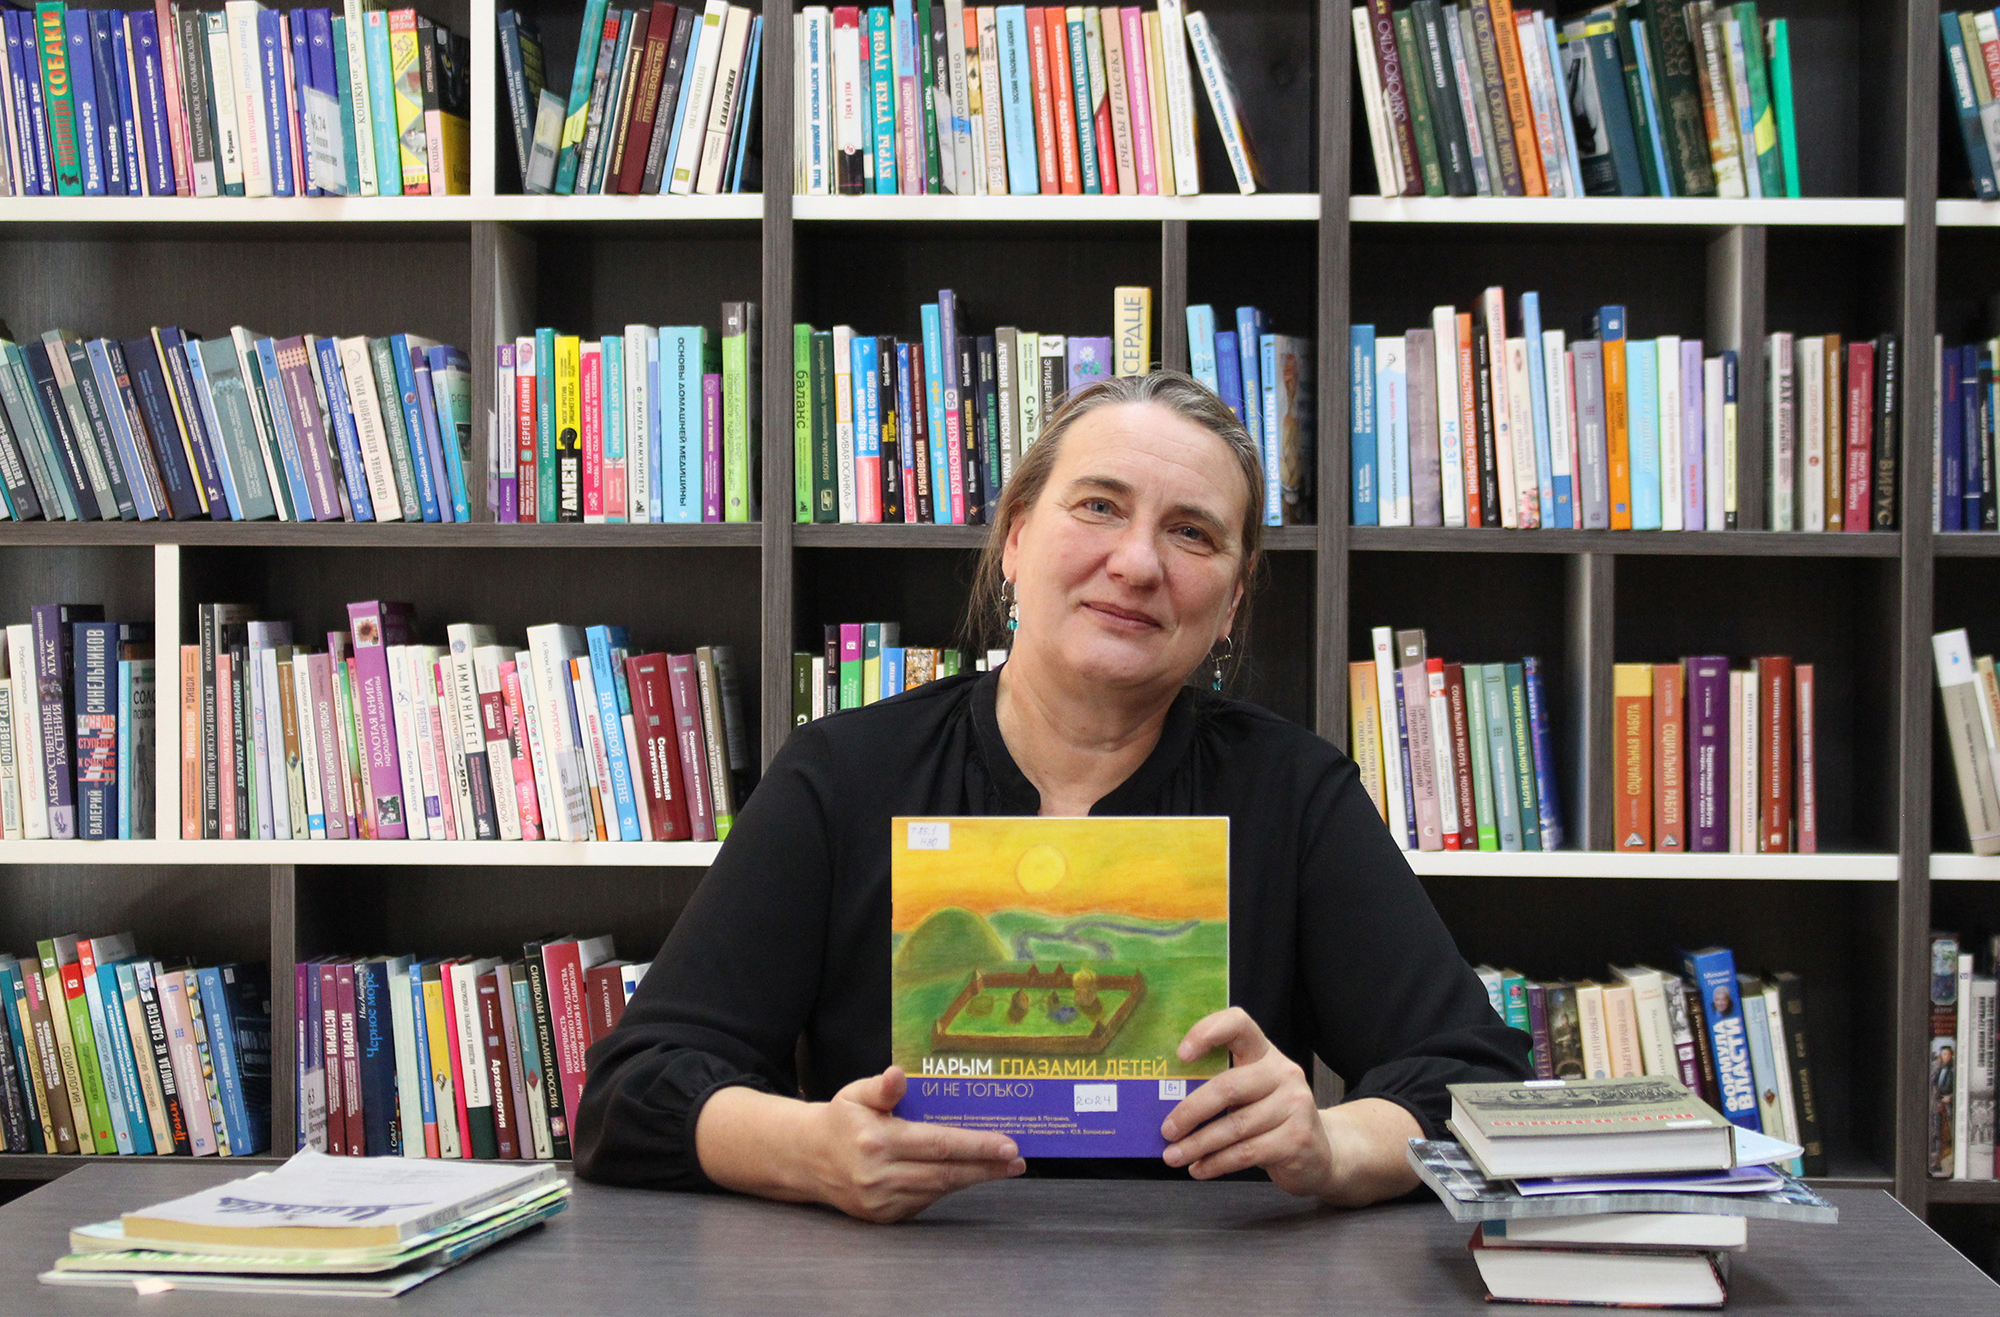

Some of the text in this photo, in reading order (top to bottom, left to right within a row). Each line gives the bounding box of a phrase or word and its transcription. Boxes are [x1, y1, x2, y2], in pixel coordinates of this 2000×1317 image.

[42, 11, 67, 96] СОБАКИ
[241, 52, 251, 89] собака
[267, 50, 275, 76] собак
[642, 42, 665, 123] ПТИЦЕВОДСТВО
[1378, 20, 1406, 121] ЗВЕРОВОДСТВО
[31, 83, 41, 103] дог
[185, 21, 205, 157] ПРАКТИЧЕСКОЕ СОБАКОВОДСТВО
[247, 95, 257, 144] ВОСПИТАНИЕ
[354, 82, 366, 124] КОШКИ
[688, 66, 706, 129] ПТИЦЕВОДСТВО
[873, 30, 891, 179] КУРЫ УТКИ ГУСИ
[953, 54, 965, 144] ПЧЕЛОВОДСТВО
[1071, 25, 1094, 186] НАСТОЛЬНАЯ КНИГА ПЧЕЛОВОДА
[1111, 48, 1129, 169] ПЧЕЛЫ И ПАСЕКА
[83, 101, 98, 189] Эрдельтерьер
[108, 125, 120, 182] Ротвейлер
[125, 120, 137, 190] Бассет хаунд
[579, 127, 597, 188] ДОМАШНЯЯ ПТИЦА
[1059, 100, 1073, 183] ПЧЕЛОВОДСТВО
[1122, 296, 1142, 374] СЕРДЦЕ
[354, 375, 366, 395] ВРАЧА
[522, 378, 531, 445] СЕРГЕЙ АГАПКИН
[610, 362, 620, 454] СПАСАЮТ ПЕРВЫМ?
[678, 383, 686, 443] ДОМАШНЕЙ
[796, 370, 808, 429] баланс
[867, 371, 876, 409] СОСУДОВ
[999, 343, 1010, 450] ЛЕЧЕБНАЯ ФИЗИЧЕСКАЯ
[1354, 345, 1362, 433] Здоровый человек
[1363, 356, 1371, 407] окружение
[83, 380, 121, 484] ОСНОВЫ ВЕТЕРИНАРИИ
[359, 400, 378, 453] ВЕТЕРИНАРНОГО
[386, 398, 407, 458] ВЕТЕРИНАРНОГО
[410, 409, 425, 455] Справочник
[857, 389, 866, 450] КОД ЗДОРОВЬЯ
[868, 418, 877, 450] СЕРДЦА
[1461, 348, 1477, 494] ГИМНАСТИКА ПРОТИВ СТАРЕНИЯ
[370, 457, 388, 500] СПРАВОЧНИК
[562, 457, 577, 510] АМЕН
[679, 446, 687, 506] МЕДИЦИНЫ
[916, 440, 927, 495] БУБНОВСКИЙ
[946, 417, 960, 495] БУБНОВСКИЙ
[1878, 460, 1894, 525] ВИРУС
[45, 640, 56, 675] АТЛАС
[87, 629, 104, 713] СИНЕЛЬНИКОВ
[53, 704, 66, 765] РАСТЕНИЯ
[185, 677, 195, 759] КОВИД ПОСТКОВИД
[232, 680, 245, 788] ИММУНИТЕТ АТАКУЕТ
[365, 678, 383, 767] ЗОЛОТАЯ КНИГА
[374, 676, 392, 766] народной медицины
[457, 664, 477, 746] ИММУНИТЕТ
[492, 695, 504, 736] ПОЛНЫЙ
[1451, 686, 1463, 737] СОЦИАЛЬНАЯ
[0, 721, 11, 761] ОЛИВЕР
[42, 705, 59, 805] ЛЕКАРСТВЕННЫЕ
[206, 686, 217, 810] ИСТОРИЯ РУССКОЙ МЕДИЦИНЫ
[319, 702, 331, 729] ОСНОВЫ
[327, 775, 339, 813] МЕДИЦИНЫ
[600, 692, 629, 804] НА ОДНОЙ ВОЛНЕ
[648, 739, 662, 799] статистика
[657, 737, 672, 800] Социальная
[1456, 738, 1466, 767] РАБОТА
[1512, 685, 1531, 808] ТЕОРИЯ СОЦИАЛЬНОЙ РАБОТЫ
[1627, 704, 1641, 795] СОЦИАЛЬНАЯ РАБОТА
[490, 744, 508, 823] СТРЕЛЬНИКОВОЙ
[688, 731, 704, 816] Социальная статистика
[1662, 723, 1676, 824] СОЦИАЛЬНАЯ РАБОТА
[88, 790, 102, 835] ВАЛЕРИЙ
[568, 963, 579, 1002] СИМВОЛОВ
[147, 1003, 176, 1094] НИКОГДА НЕ СДАЕТСЯ
[325, 1010, 337, 1054] ИСТОРИЯ
[342, 1013, 354, 1058] ИСТОРИЯ
[365, 1009, 382, 1057] Черное
[529, 965, 545, 1014] СИМВОЛЫ
[538, 1025, 552, 1066] РЕГАЛИИ
[545, 1069, 558, 1108] РОССИИ
[559, 1016, 573, 1073] ИДЕНТИЧНОСТЬ
[561, 968, 580, 1073] РОССИЙСКОГО ГОСУДАРСТВА
[574, 1011, 583, 1040] ЗНАКОВ
[62, 1046, 81, 1104] СОЦИОЛОГИЯ
[491, 1060, 507, 1128] Археология
[922, 1056, 1169, 1080] НАРЫМ ГЛАЗАМИ ДЕТЕЙ
[922, 1083, 1034, 1099] (И НЕ ТОЛЬКО)
[1712, 1020, 1738, 1112] ФОРМУЛА
[1724, 1017, 1756, 1110] ВЛАСТИ
[170, 1099, 186, 1144] Трамп
[1076, 1095, 1112, 1107] 2024
